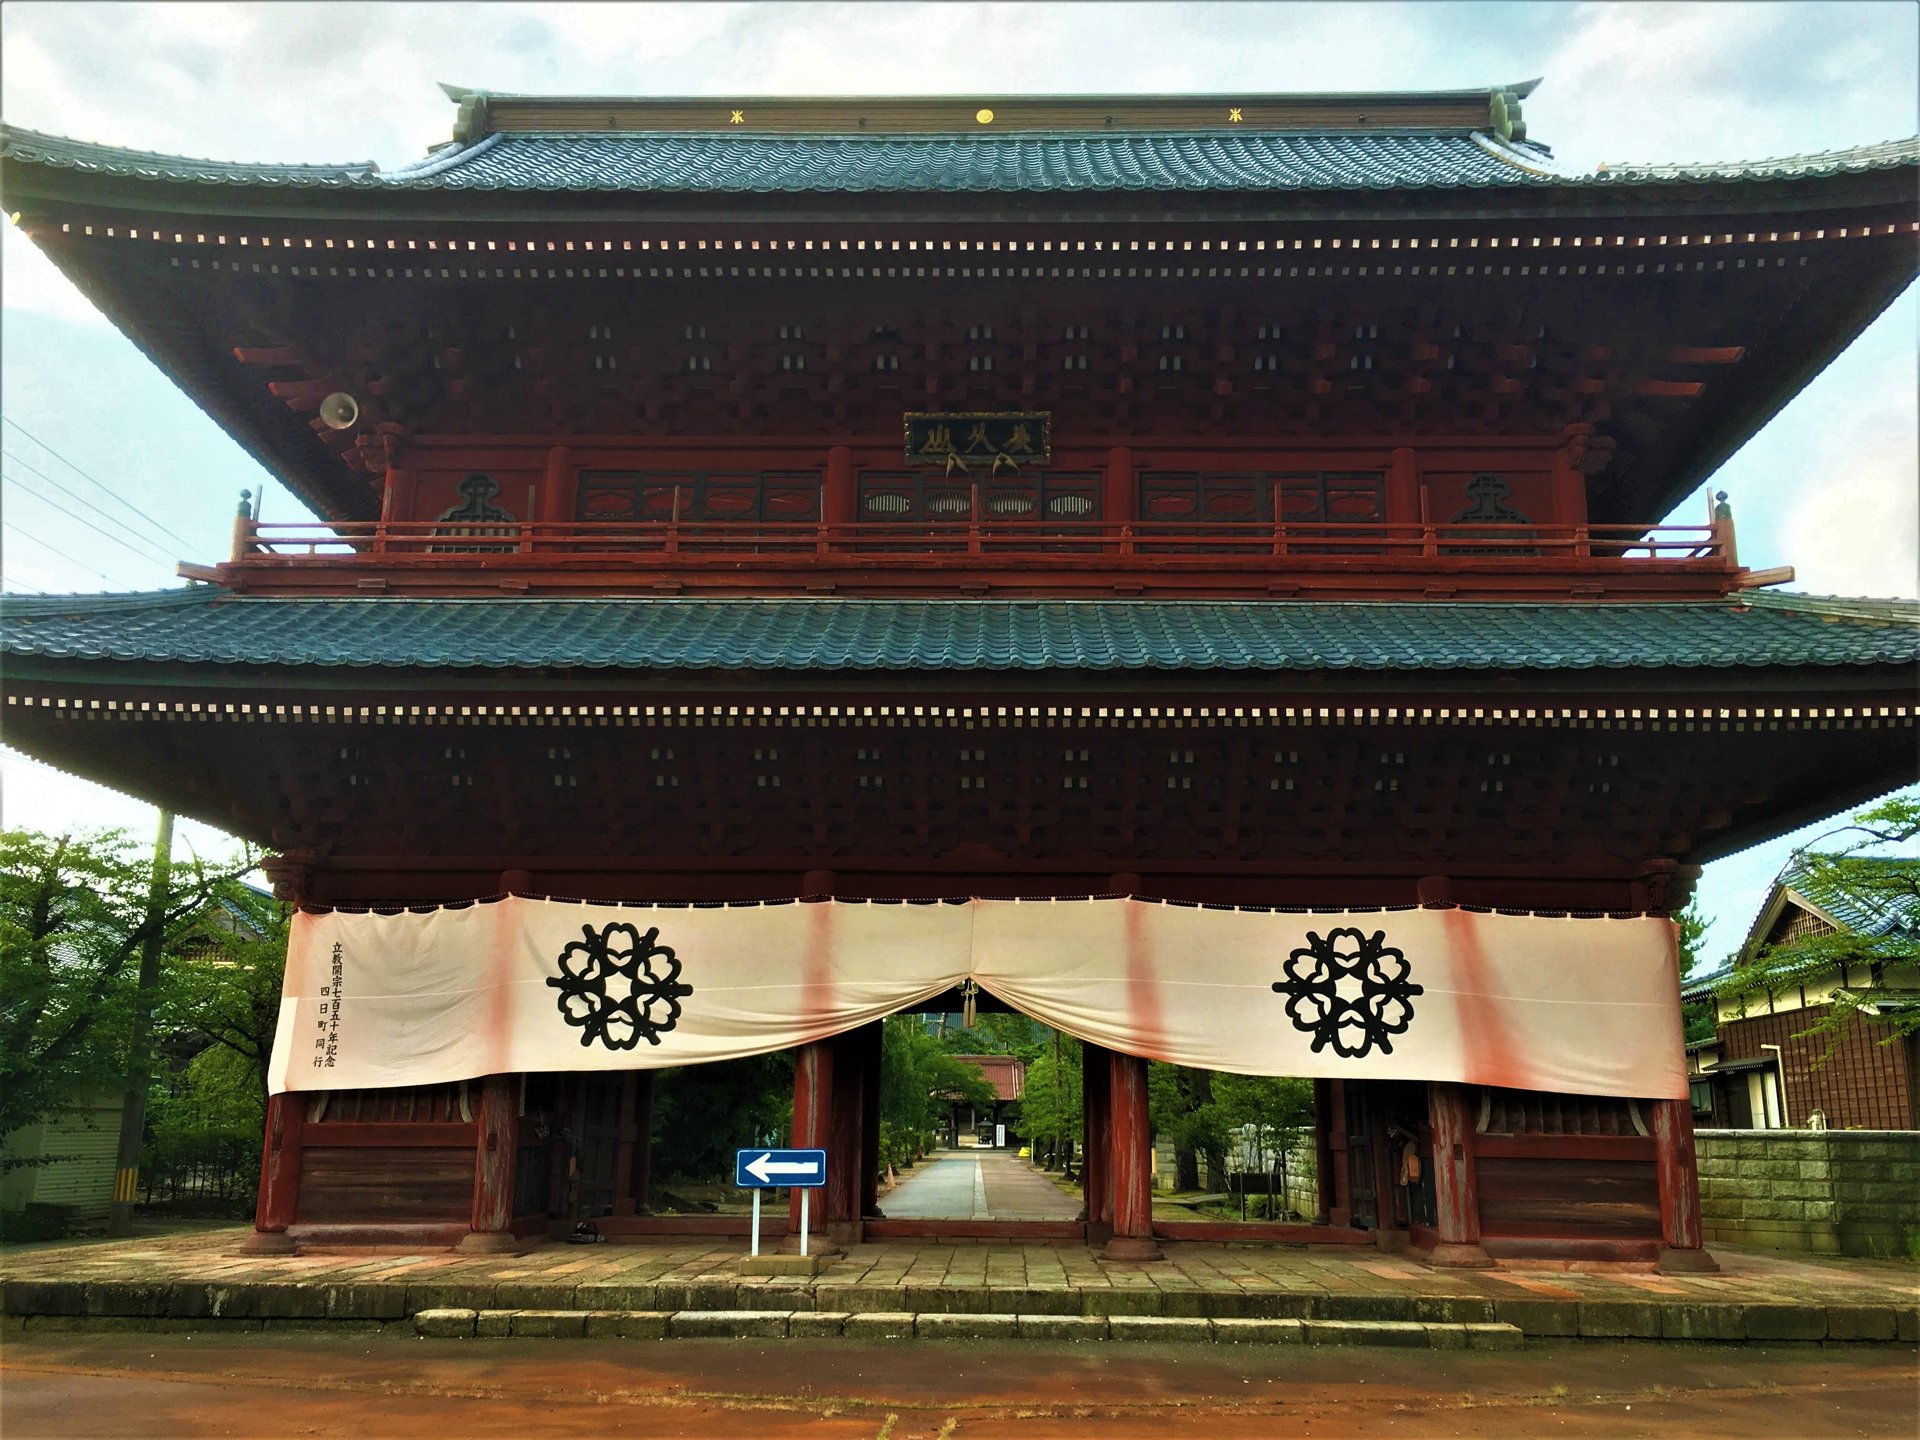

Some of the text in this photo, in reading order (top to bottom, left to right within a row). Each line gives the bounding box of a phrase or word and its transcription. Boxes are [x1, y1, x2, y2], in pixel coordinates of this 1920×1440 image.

[313, 986, 330, 1068] 四日町同行
[324, 942, 343, 1068] 立教開宗七百五十年記念
